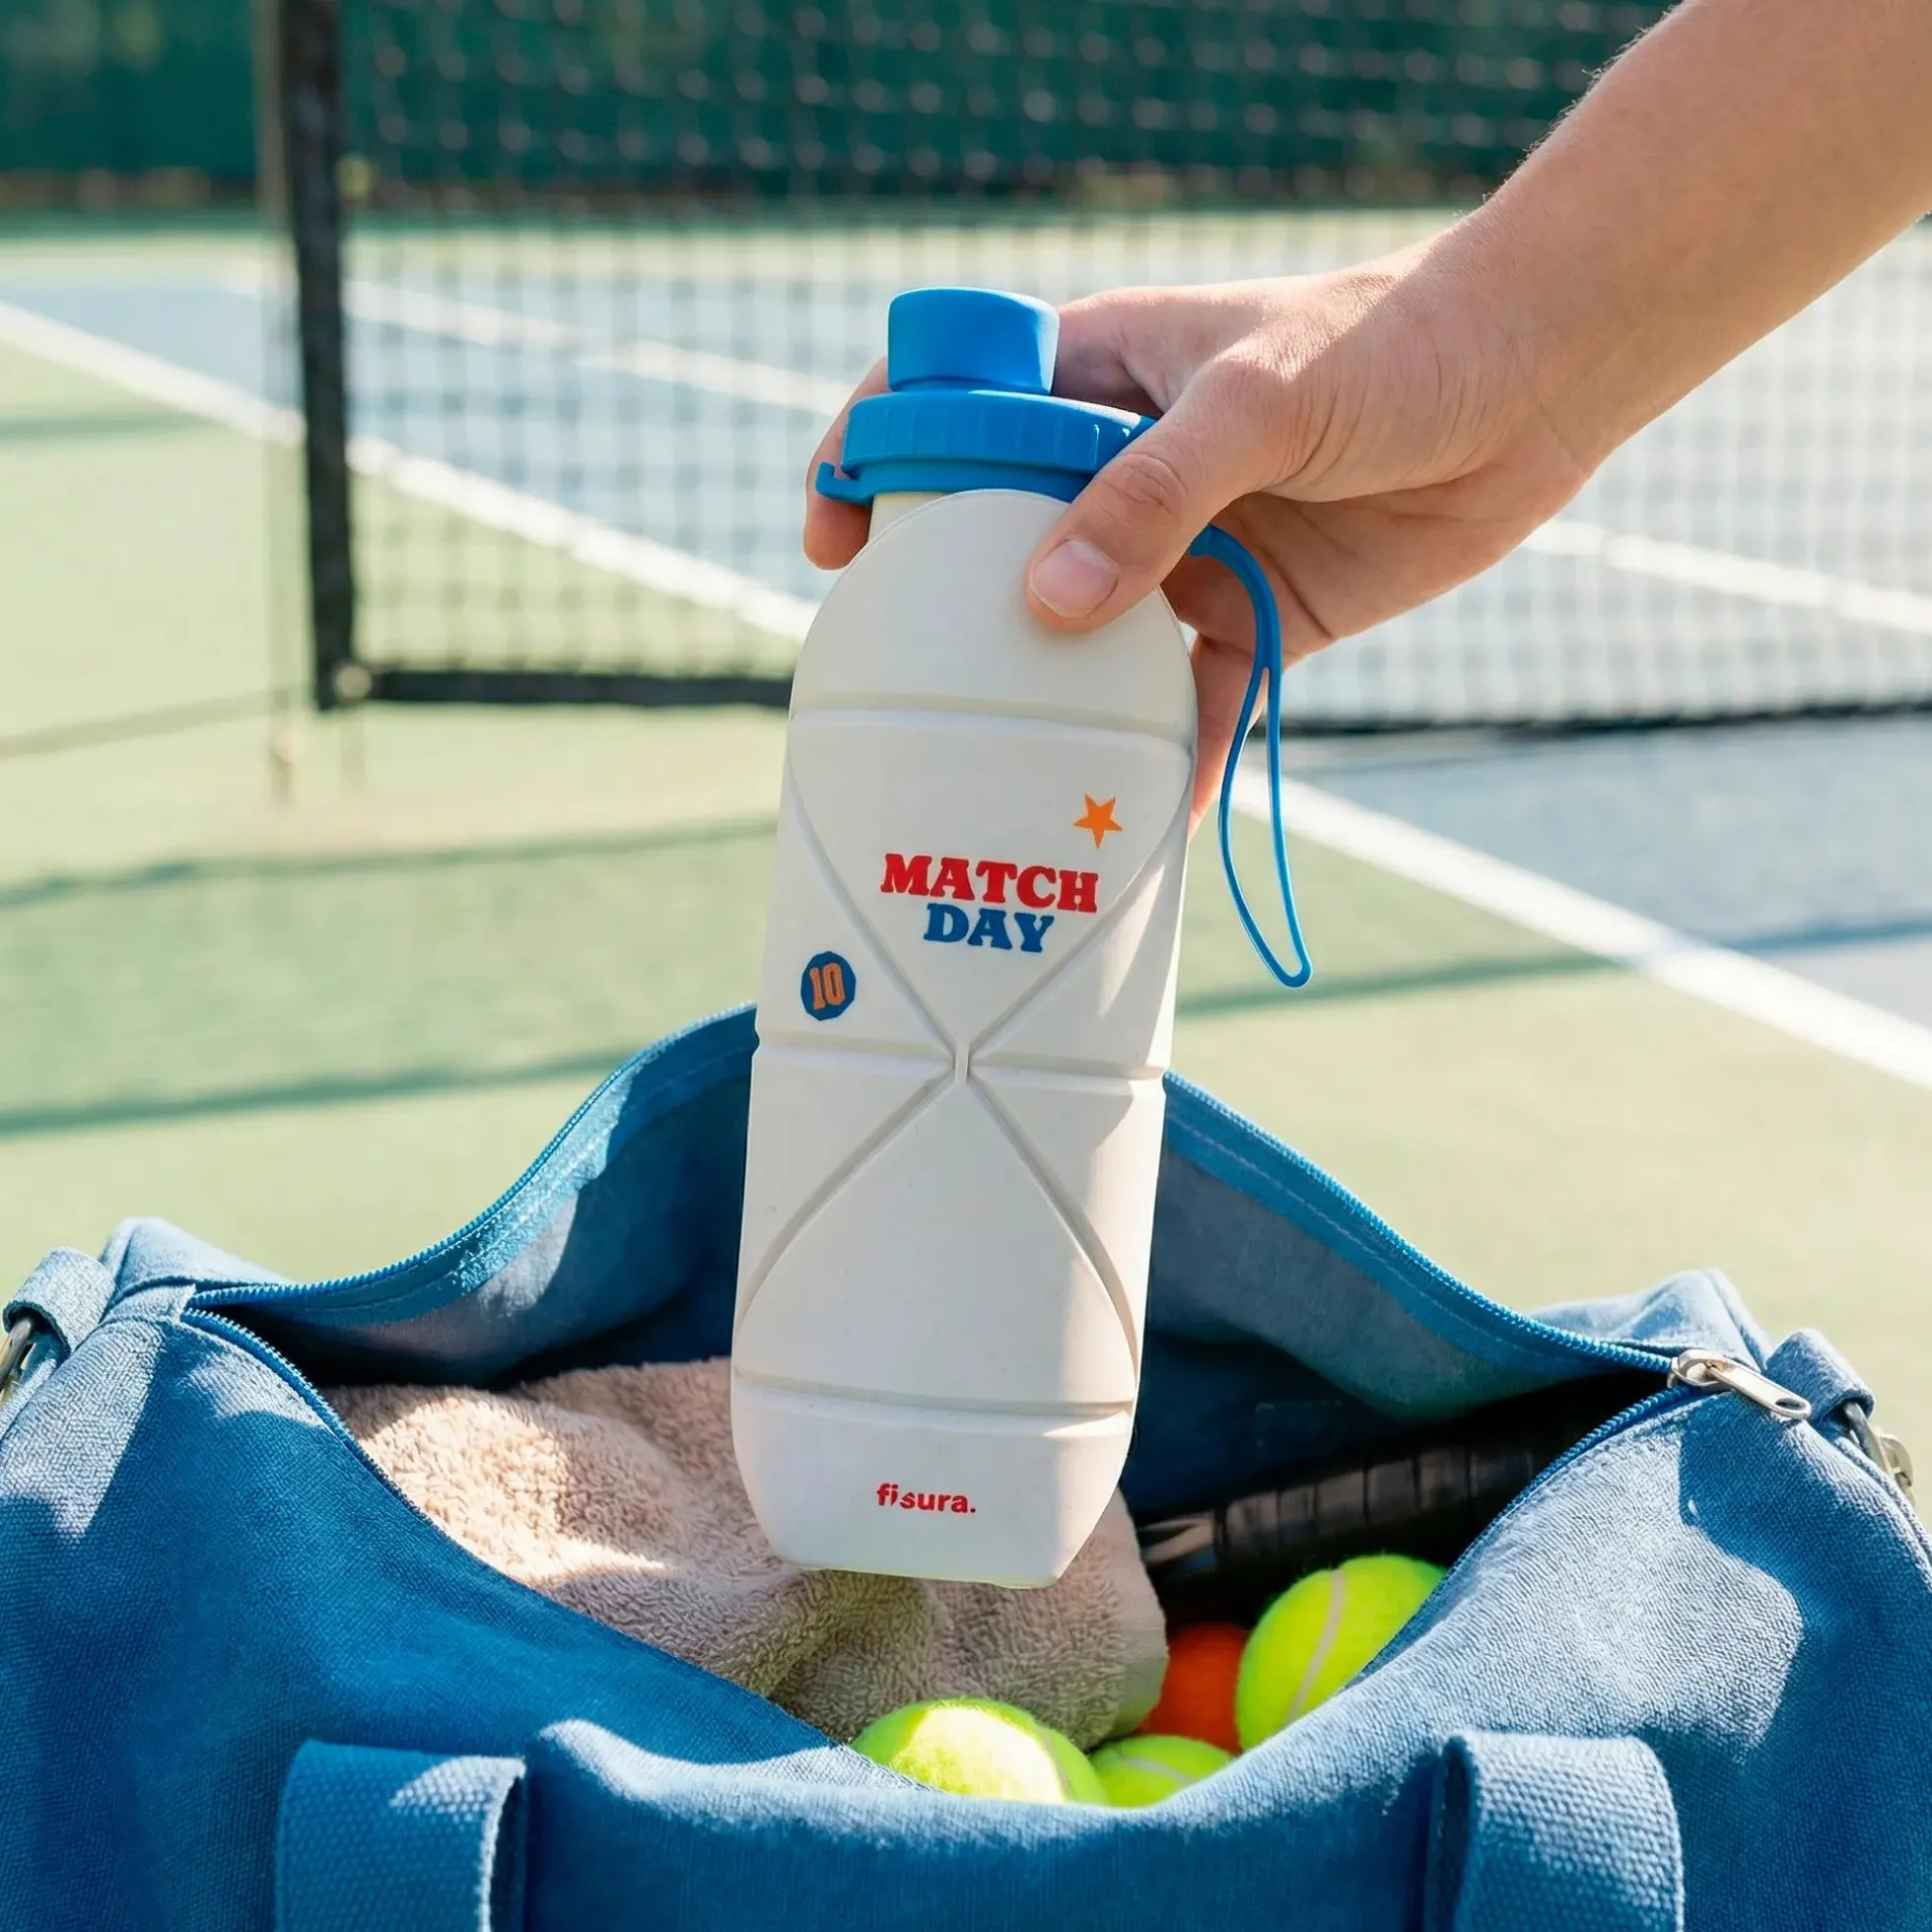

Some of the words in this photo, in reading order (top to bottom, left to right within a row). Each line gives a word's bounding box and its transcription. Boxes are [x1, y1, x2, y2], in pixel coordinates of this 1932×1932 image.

[880, 853, 1099, 913] MATCH
[924, 903, 1055, 953] DAY
[809, 962, 846, 1010] 10
[876, 1483, 976, 1514] fisura.
